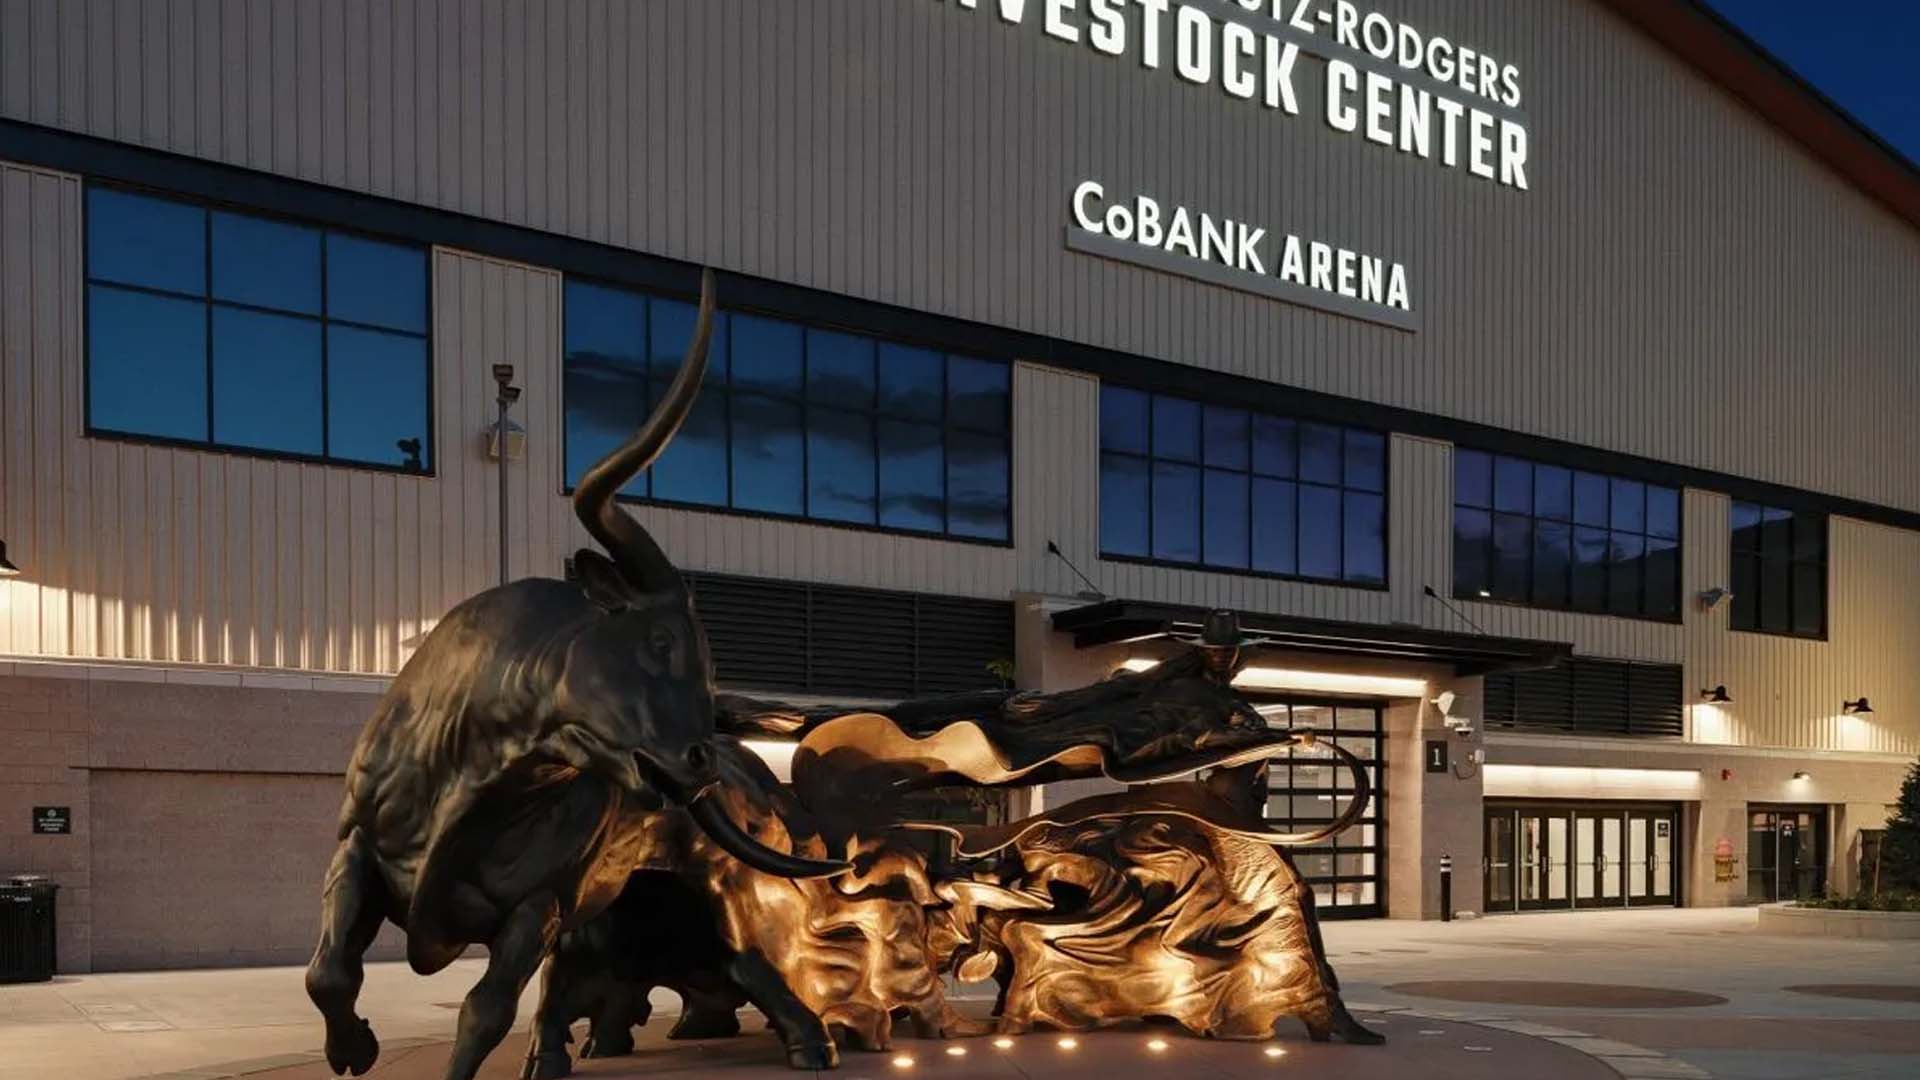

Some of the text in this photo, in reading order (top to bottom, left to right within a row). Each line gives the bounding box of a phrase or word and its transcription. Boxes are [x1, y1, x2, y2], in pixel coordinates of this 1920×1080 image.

[960, 0, 1529, 190] ESTOCK CENTER
[1237, 0, 1521, 108] Z-RODGERS
[1073, 180, 1410, 311] CoBANK ARENA
[1433, 748, 1441, 766] 1
